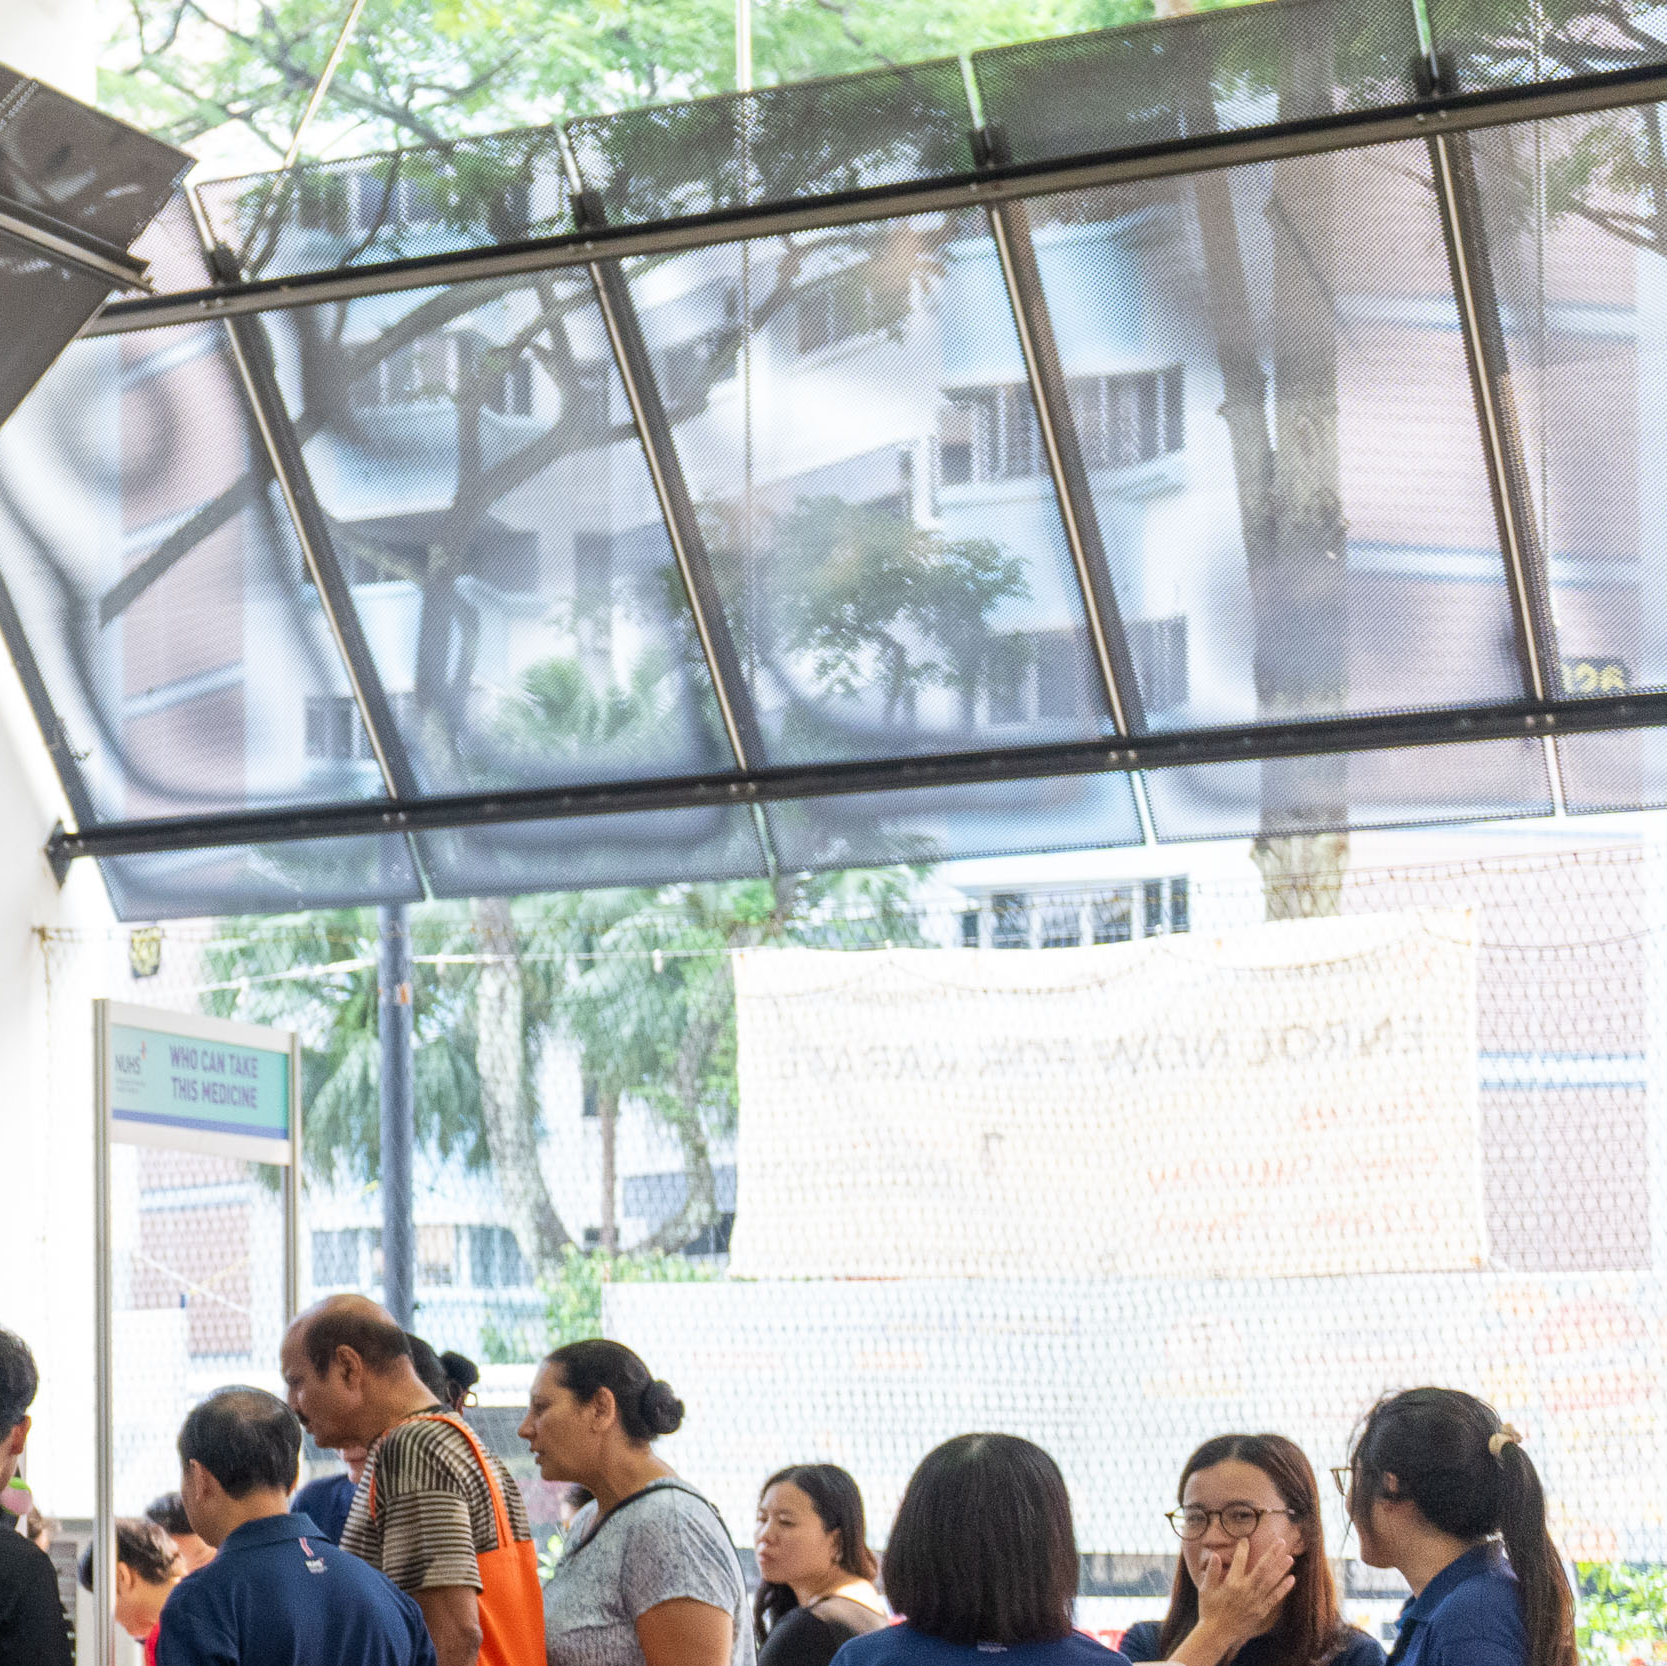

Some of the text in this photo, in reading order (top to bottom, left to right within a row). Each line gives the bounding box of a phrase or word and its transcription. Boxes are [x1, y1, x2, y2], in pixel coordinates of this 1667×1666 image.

[115, 1055, 141, 1075] NUHS
[169, 1044, 259, 1079] WHO CAN TAKE
[170, 1076, 198, 1103] THIS
[201, 1080, 258, 1110] MEDICINE
